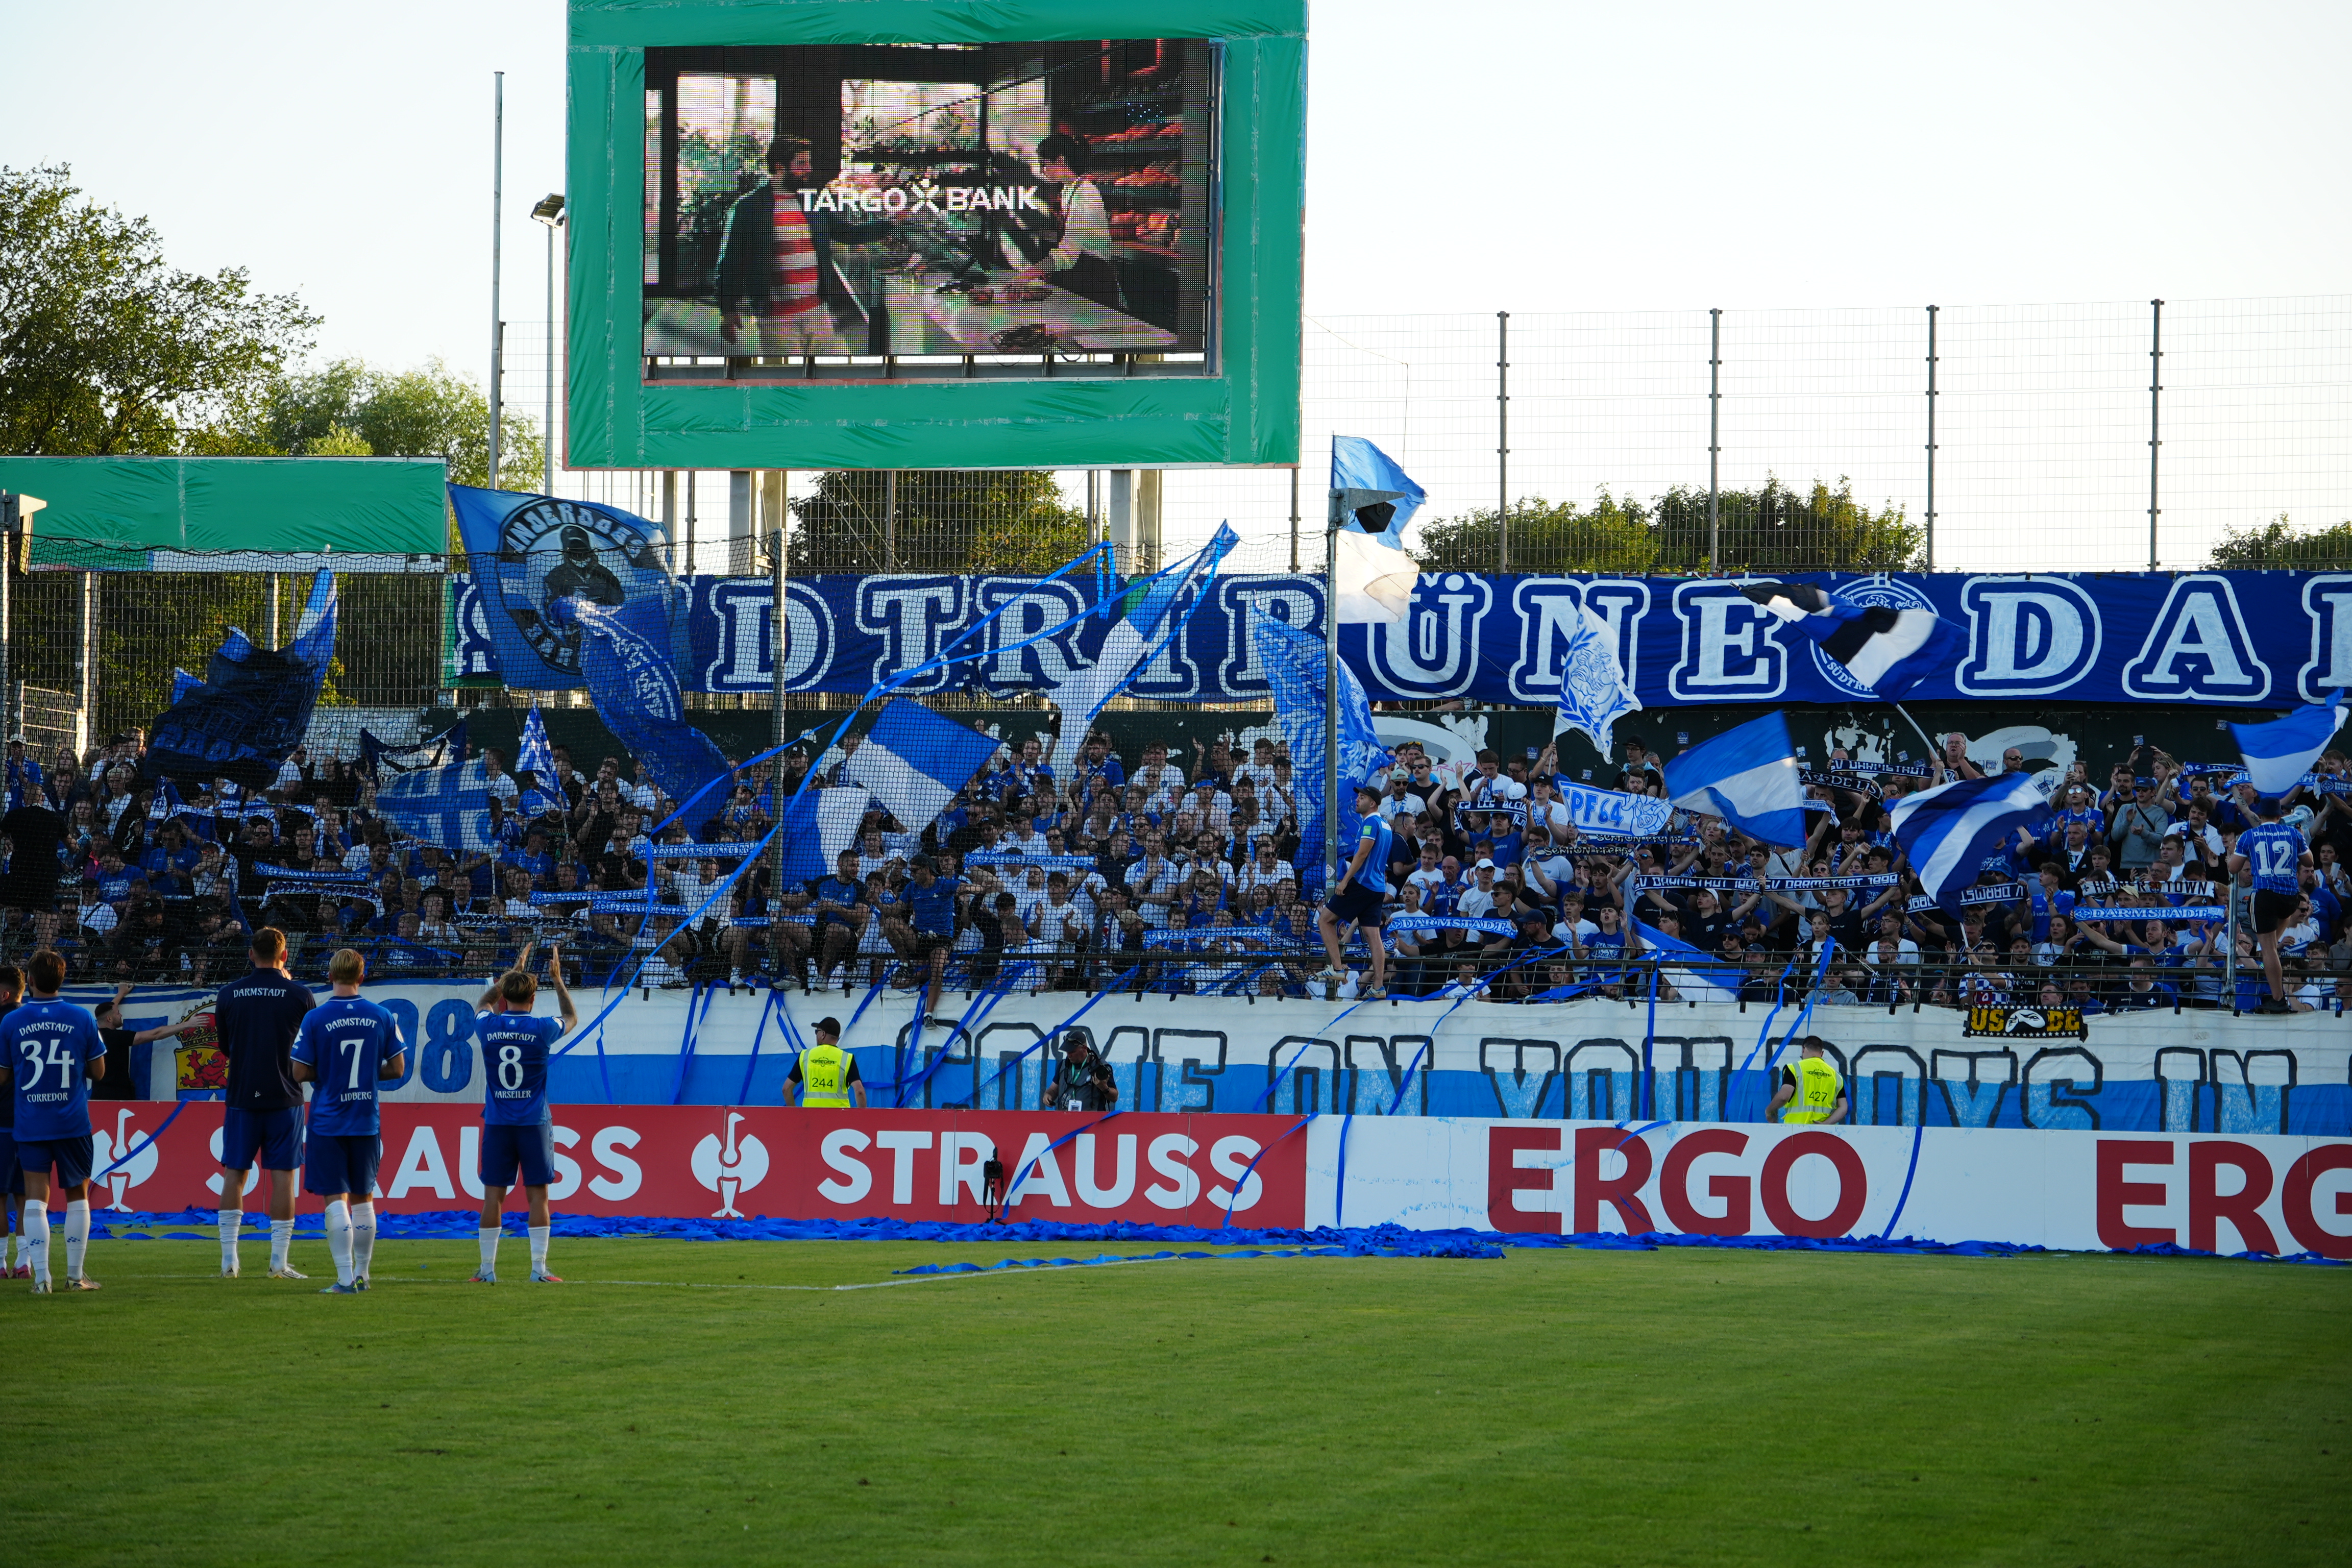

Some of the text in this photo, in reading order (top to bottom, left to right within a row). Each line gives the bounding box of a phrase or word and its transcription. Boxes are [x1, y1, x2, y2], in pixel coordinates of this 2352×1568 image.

[797, 184, 1039, 213] TARGO BANK
[456, 573, 1788, 702] DTRIBÜNE
[1831, 776, 1852, 787] DE
[2255, 840, 2293, 877] 12
[1653, 876, 1726, 888] DARMSTADT
[1765, 873, 1898, 889] SV DARMSTADT 1898
[2165, 881, 2208, 895] TOWN
[1960, 886, 2011, 902] DARMST
[2092, 908, 2208, 919] DARMSTADT
[1402, 918, 1506, 933] DARMSTADT
[233, 987, 286, 999] DARMSTADT
[325, 1017, 377, 1032] DARMSTADT
[1971, 1008, 2004, 1032] US
[18, 1022, 75, 1037] DARMSTADT
[486, 1032, 536, 1043] DARMSTADT
[20, 1039, 75, 1091] 34
[340, 1039, 364, 1089] 7
[497, 1045, 524, 1090] 8
[812, 1077, 834, 1088] 244
[896, 1019, 1227, 1113] COME
[1267, 1035, 1434, 1116] ON
[1479, 1036, 1733, 1121] YOU
[2153, 1046, 2298, 1134] IN
[27, 1092, 68, 1103] CORREDOR
[340, 1091, 372, 1102] LIDBERG
[1808, 1091, 1828, 1102] 427
[206, 1125, 642, 1201] AUSS
[817, 1128, 1263, 1211] STRAUSS
[1488, 1126, 1867, 1238] ERGO
[2096, 1139, 2352, 1260] ERG
